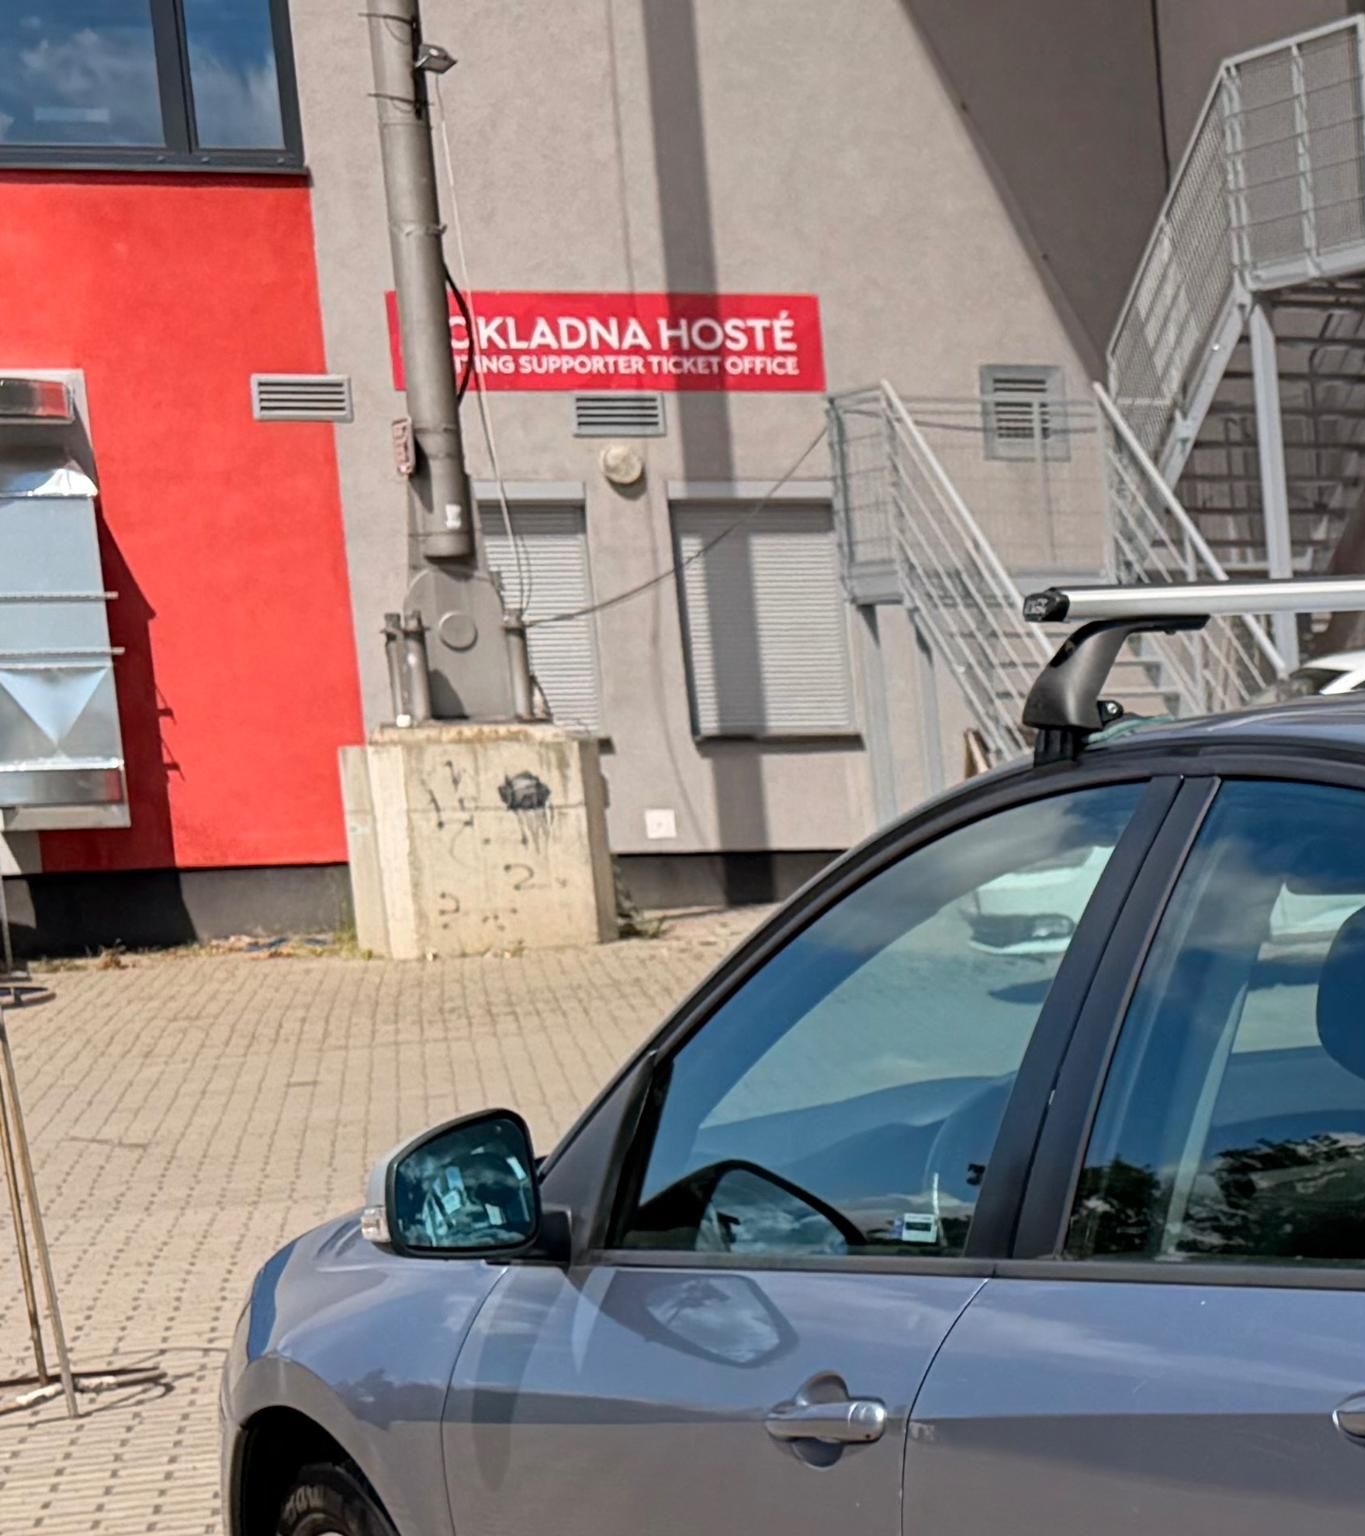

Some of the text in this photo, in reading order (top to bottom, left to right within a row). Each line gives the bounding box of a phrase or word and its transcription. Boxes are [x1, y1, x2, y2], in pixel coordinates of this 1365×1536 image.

[449, 309, 798, 351] OKLADNA HOSTÉ
[454, 355, 800, 376] TING SUPPORTER TICKET OFFICE
